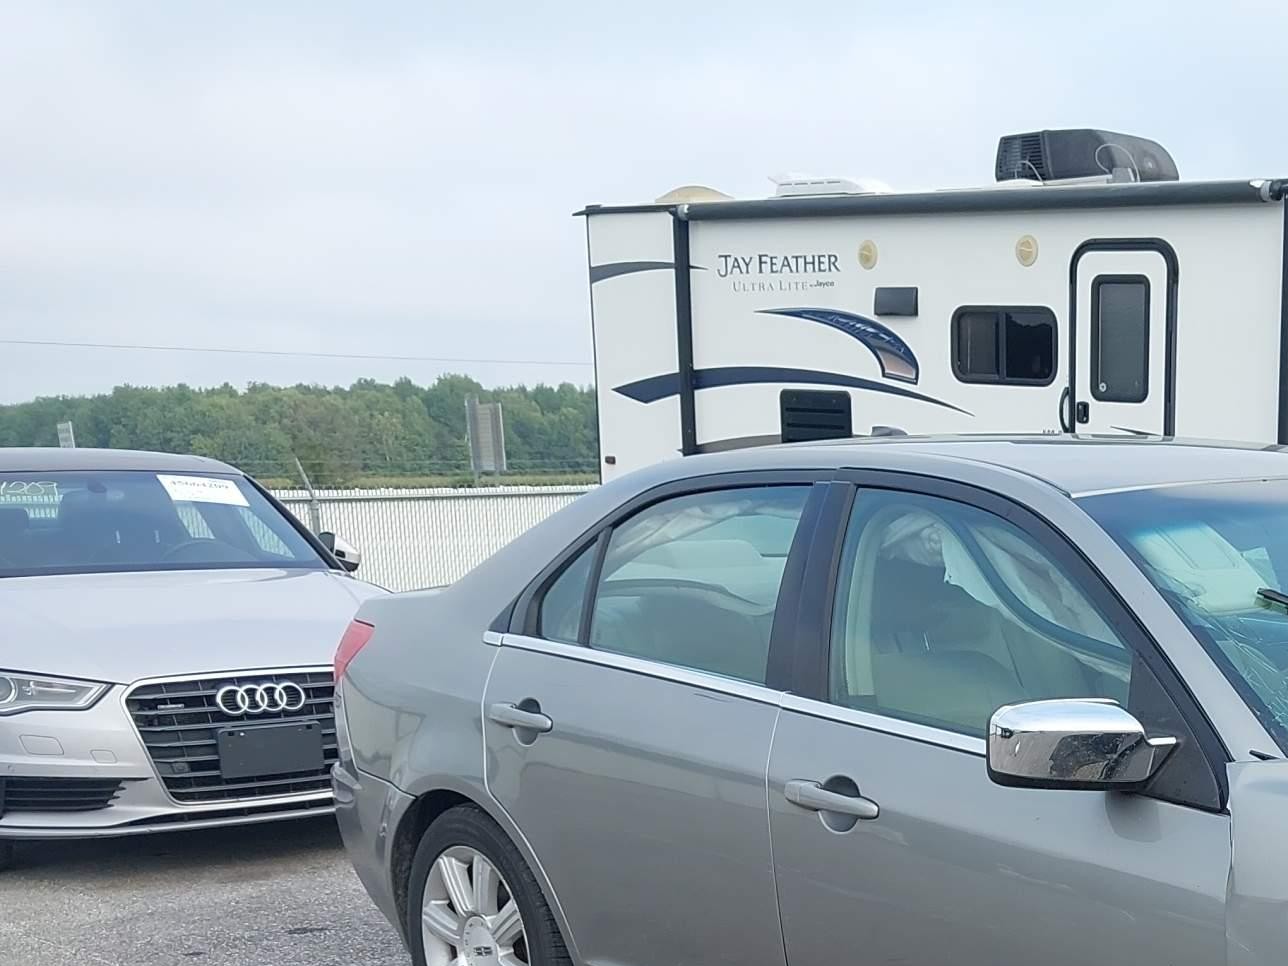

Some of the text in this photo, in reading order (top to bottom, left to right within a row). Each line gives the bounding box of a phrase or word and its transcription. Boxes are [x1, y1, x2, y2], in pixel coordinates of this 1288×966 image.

[717, 253, 841, 278] JAY FEATHER
[732, 281, 775, 292] ULTRA
[779, 280, 808, 291] LITE
